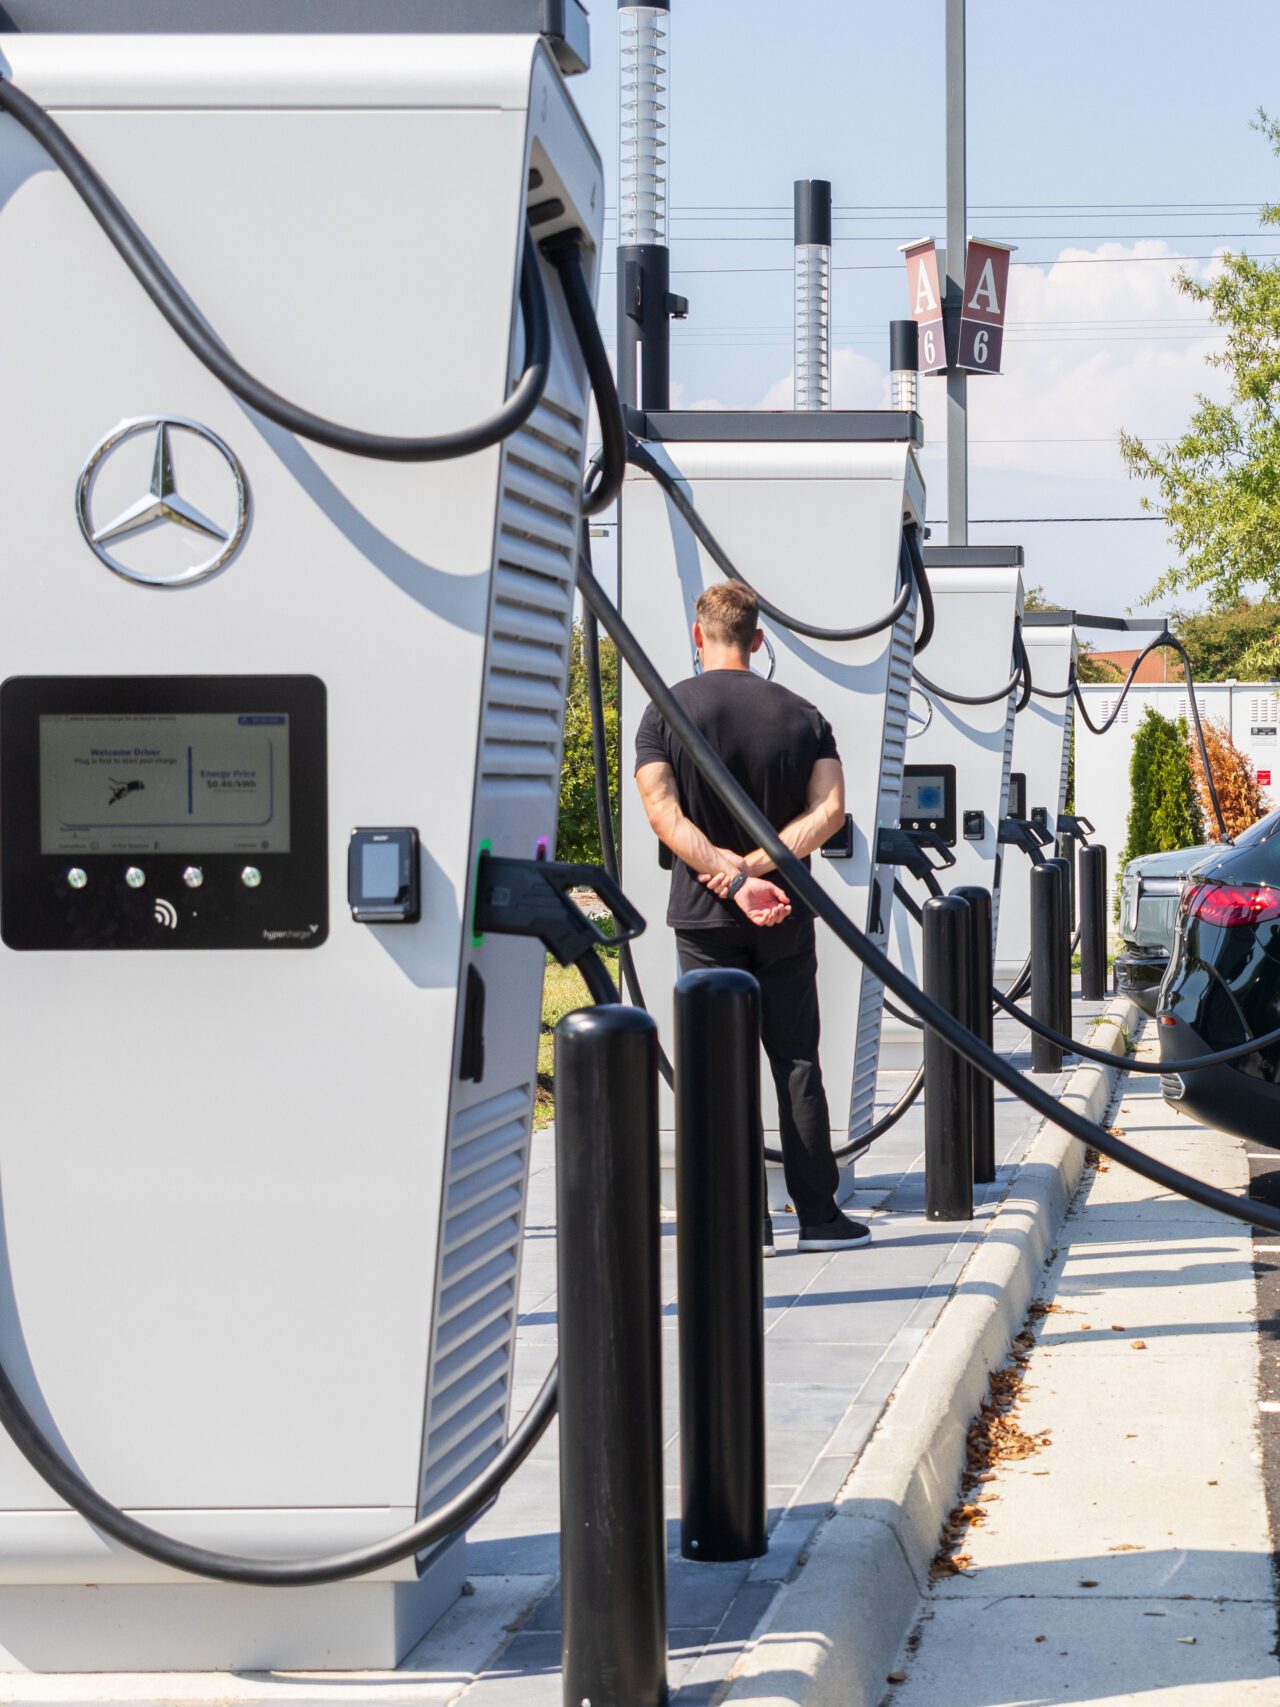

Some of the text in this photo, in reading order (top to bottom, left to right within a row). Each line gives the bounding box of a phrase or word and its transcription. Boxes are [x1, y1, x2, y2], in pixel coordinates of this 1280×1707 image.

[914, 257, 938, 315] A
[967, 257, 1001, 315] A
[923, 330, 936, 364] 6
[973, 330, 989, 364] 6
[90, 748, 161, 756] Welcome Driver
